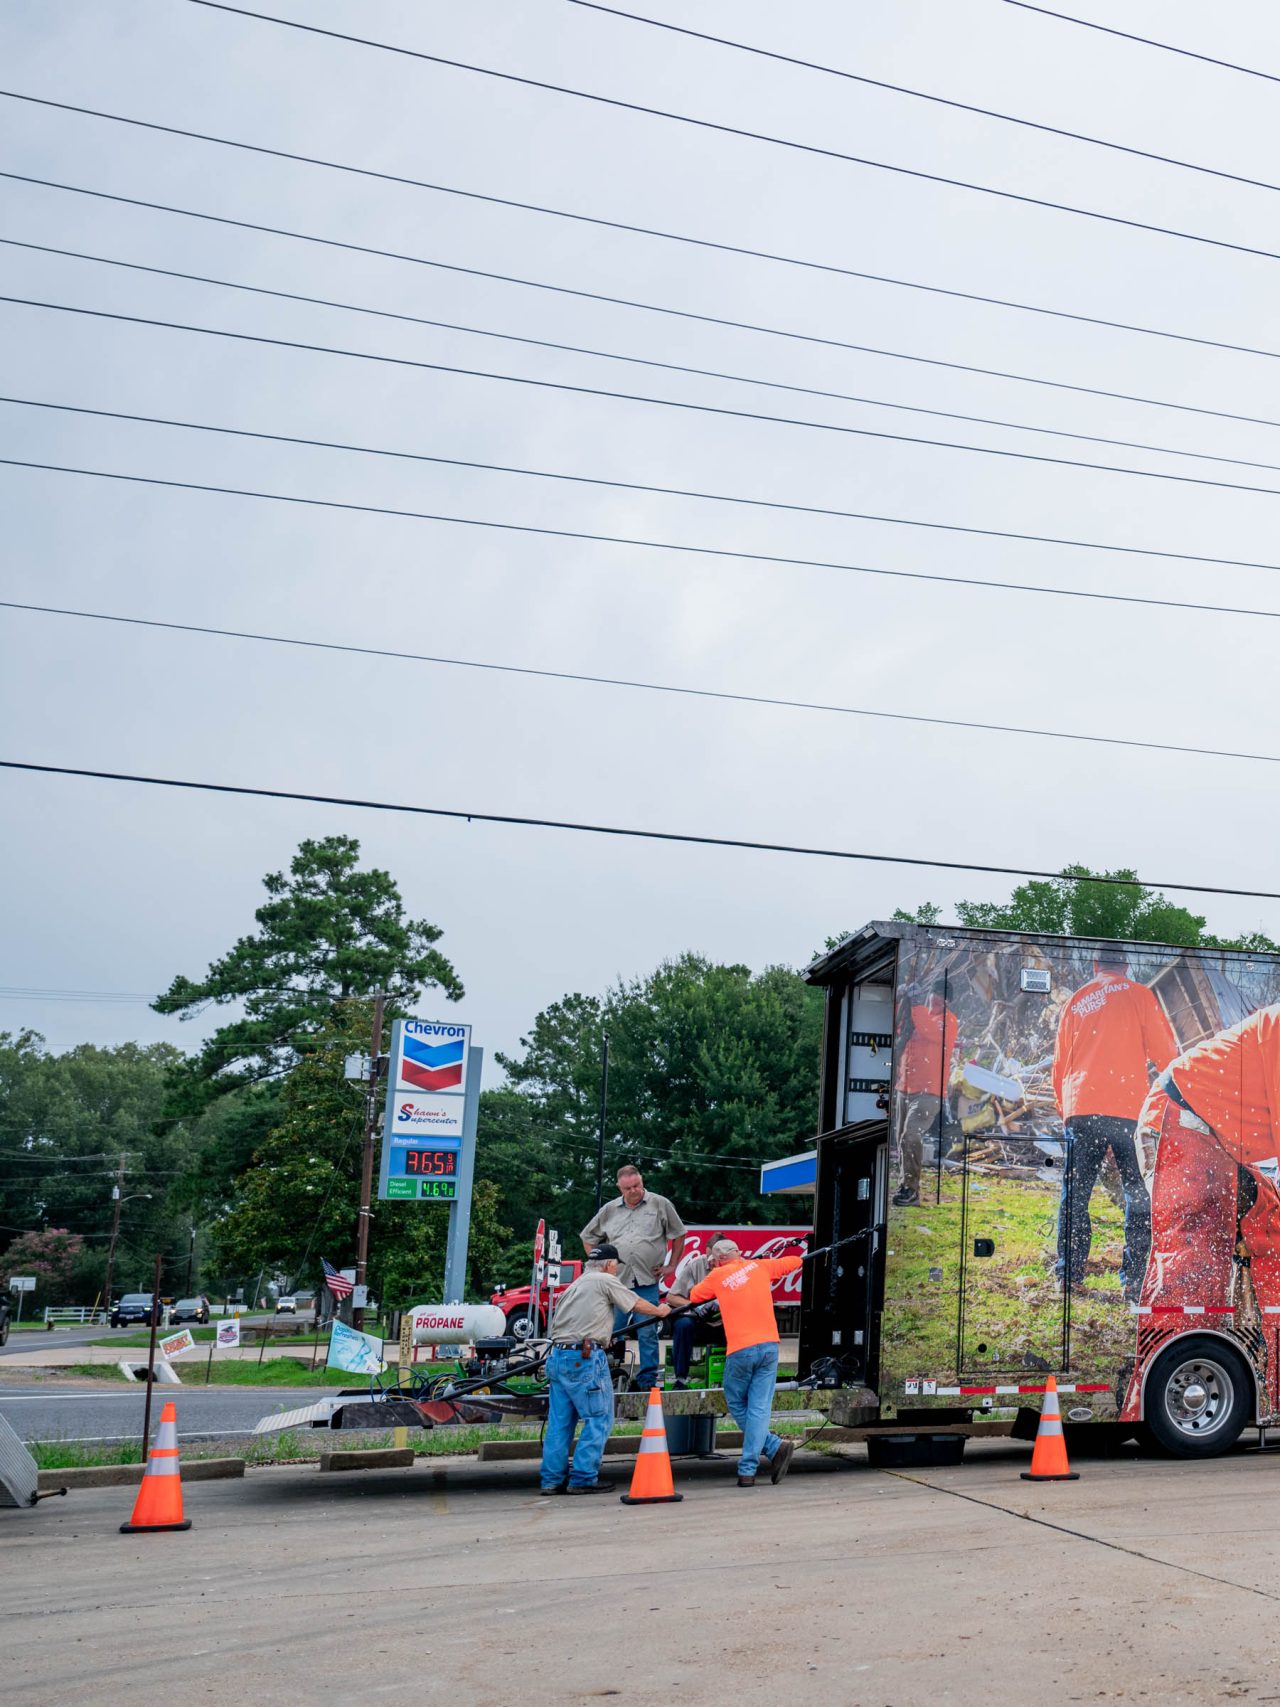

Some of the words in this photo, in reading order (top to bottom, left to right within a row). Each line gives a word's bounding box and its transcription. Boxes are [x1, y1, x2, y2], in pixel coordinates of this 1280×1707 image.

[404, 1020, 466, 1037] Chevron
[398, 1103, 447, 1121] Shawn's
[393, 1137, 418, 1145] Regular
[415, 1317, 465, 1329] PROPANE
